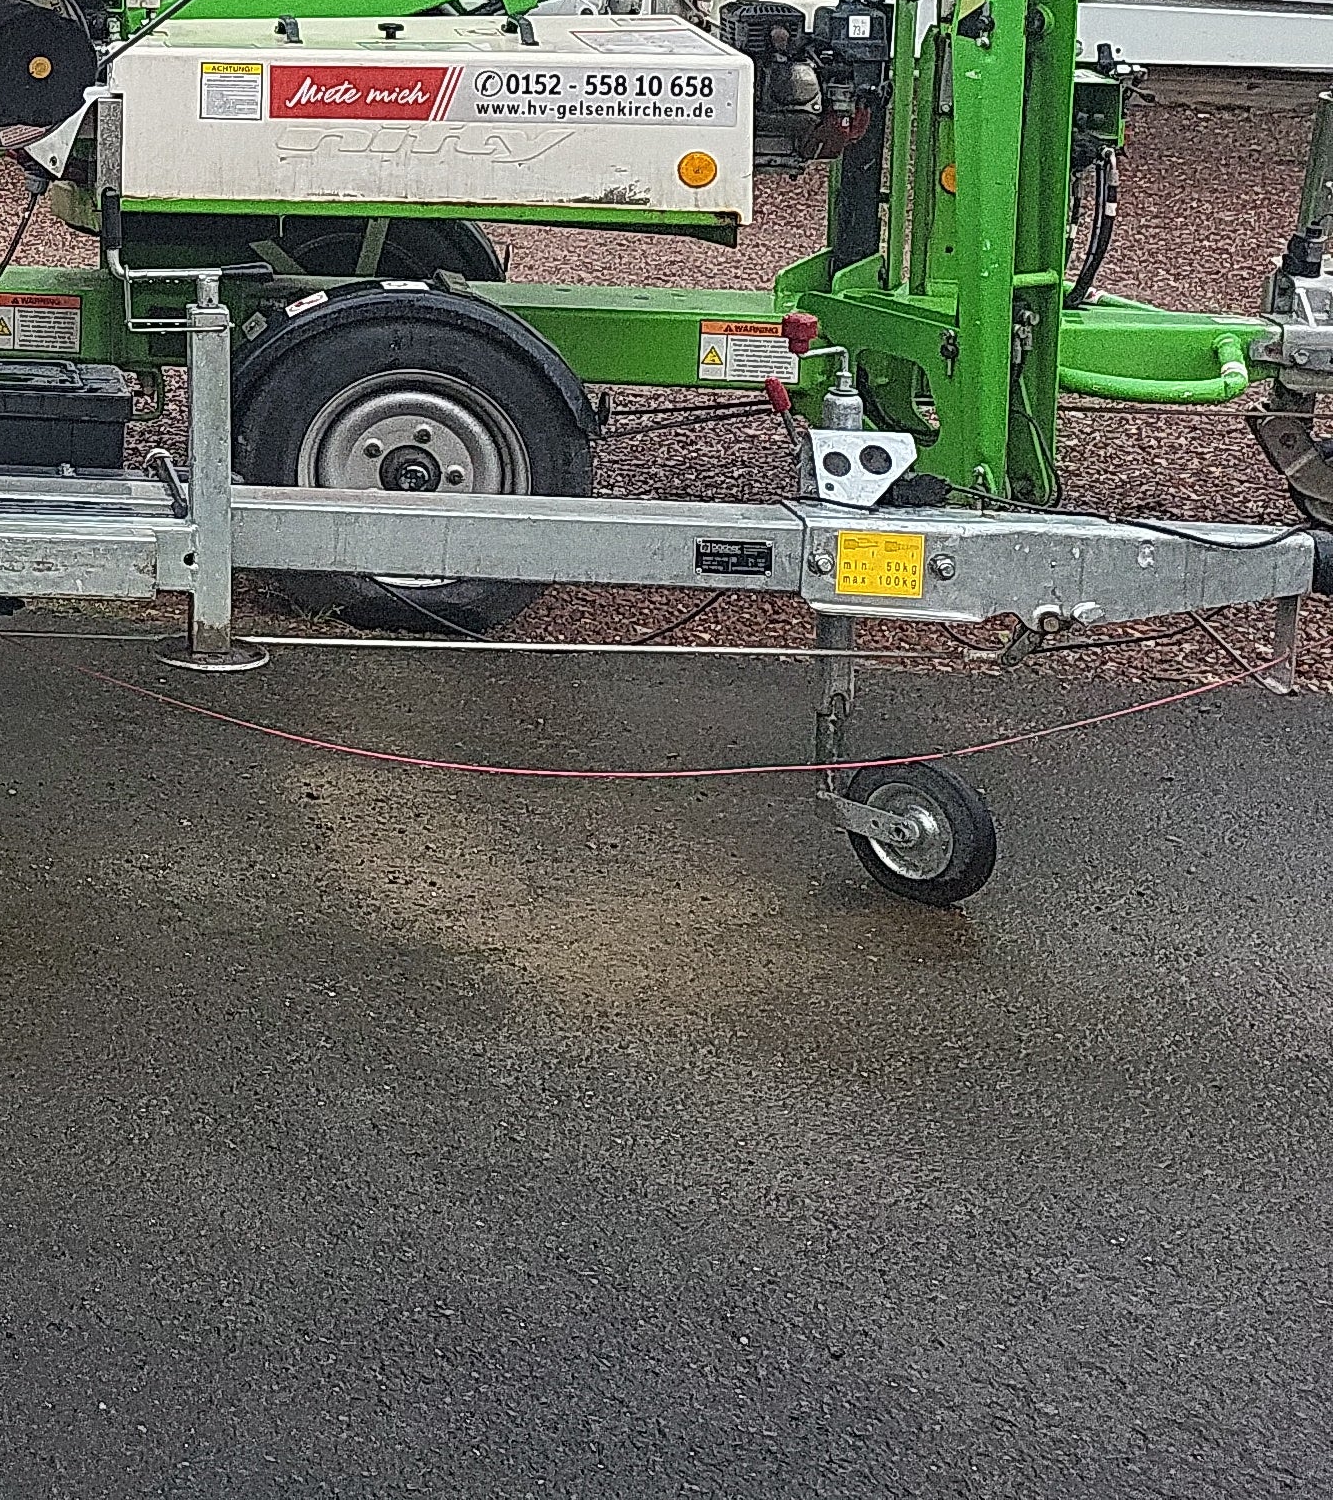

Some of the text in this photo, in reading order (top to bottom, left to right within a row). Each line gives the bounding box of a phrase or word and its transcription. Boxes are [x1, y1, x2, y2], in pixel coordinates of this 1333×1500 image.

[285, 76, 362, 108] Miete
[366, 81, 430, 105] mich
[506, 73, 561, 96] 0152
[584, 74, 627, 97] 558
[635, 75, 662, 97] 10
[670, 75, 714, 98] 658
[476, 100, 714, 119] www.hv-gelsenkirchen.de
[276, 121, 576, 164] nifty
[879, 575, 917, 590] 100kg
